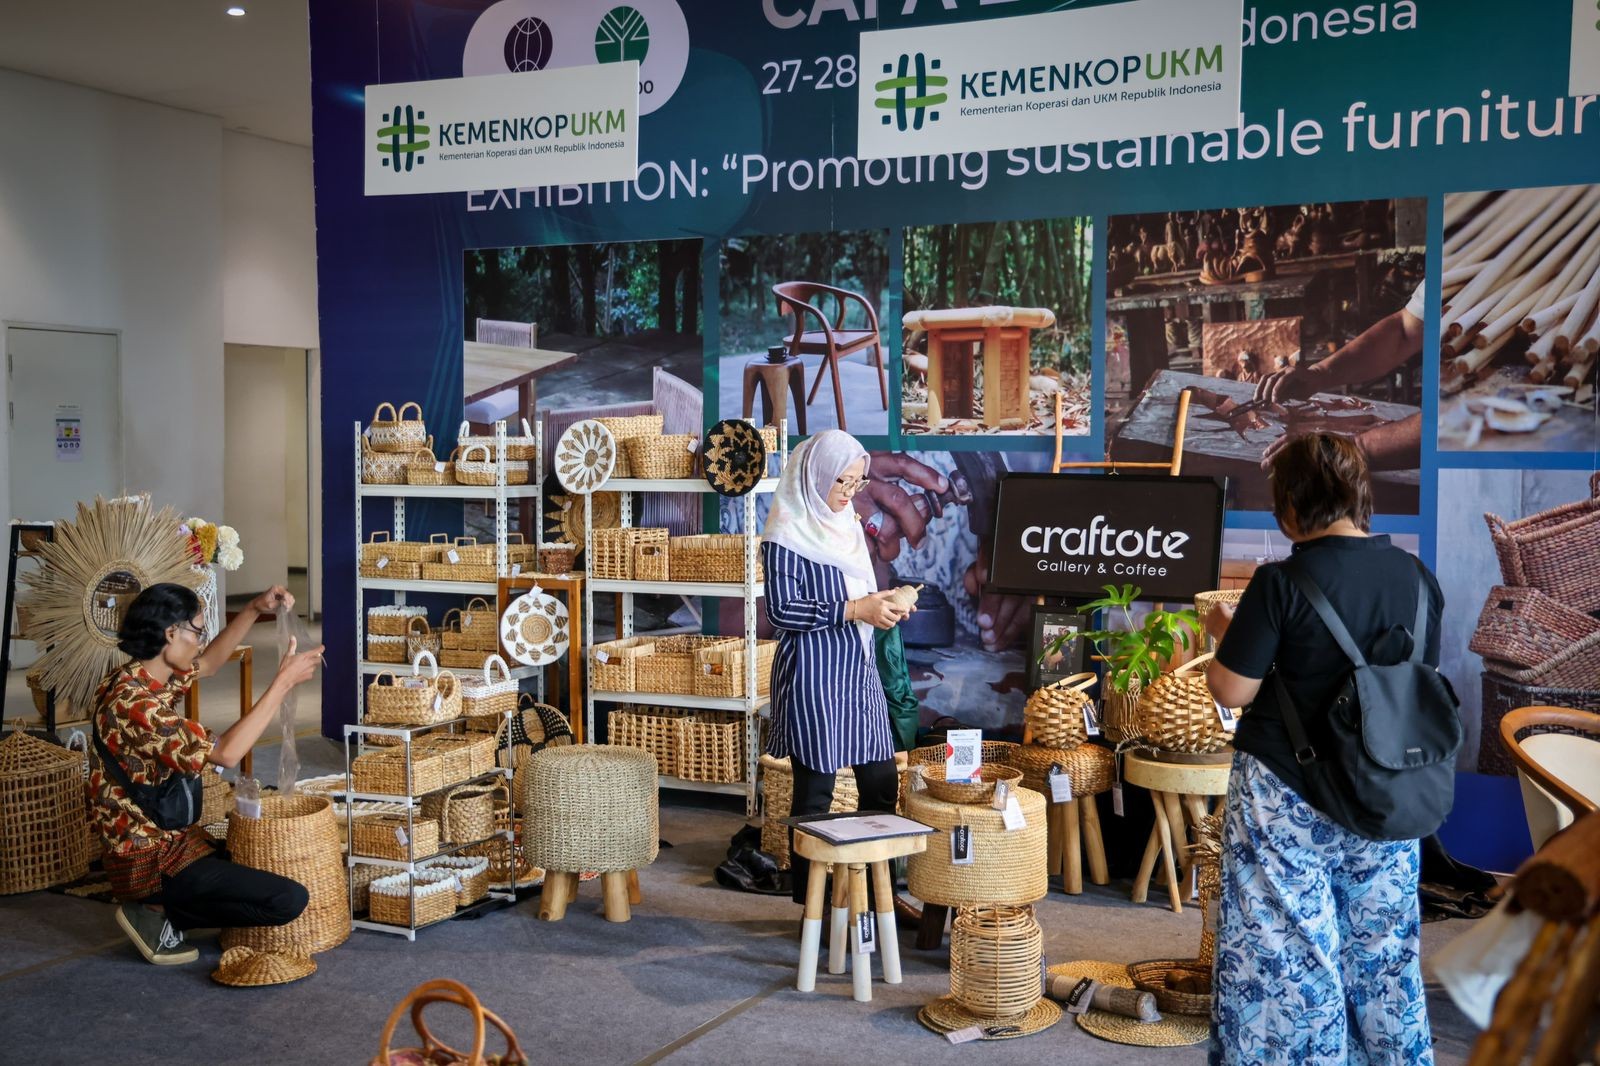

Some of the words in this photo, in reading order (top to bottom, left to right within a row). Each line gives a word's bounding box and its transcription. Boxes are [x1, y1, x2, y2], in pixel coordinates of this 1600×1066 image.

[762, 54, 857, 95] 27-28
[961, 45, 1223, 100] KEMENKOPUKM
[960, 103, 1023, 117] Kementerian
[1025, 98, 1069, 113] Koperasi
[1071, 96, 1090, 107] dan
[1093, 93, 1118, 105] UKM
[1120, 88, 1166, 103] Republik
[1169, 81, 1222, 96] Indonesia
[439, 108, 625, 147] KEMENKOPUKM
[1342, 89, 1600, 152] furnitur
[439, 150, 485, 161] Kementerian
[486, 147, 518, 159] Koperasi
[518, 147, 533, 156] dan
[534, 145, 552, 155] UKM
[553, 142, 586, 154] Republik
[587, 140, 625, 151] Indonesia
[1021, 515, 1190, 560] craftote
[1037, 559, 1091, 575] Gallery
[1097, 563, 1107, 574] &
[1113, 563, 1167, 577] Coffee
